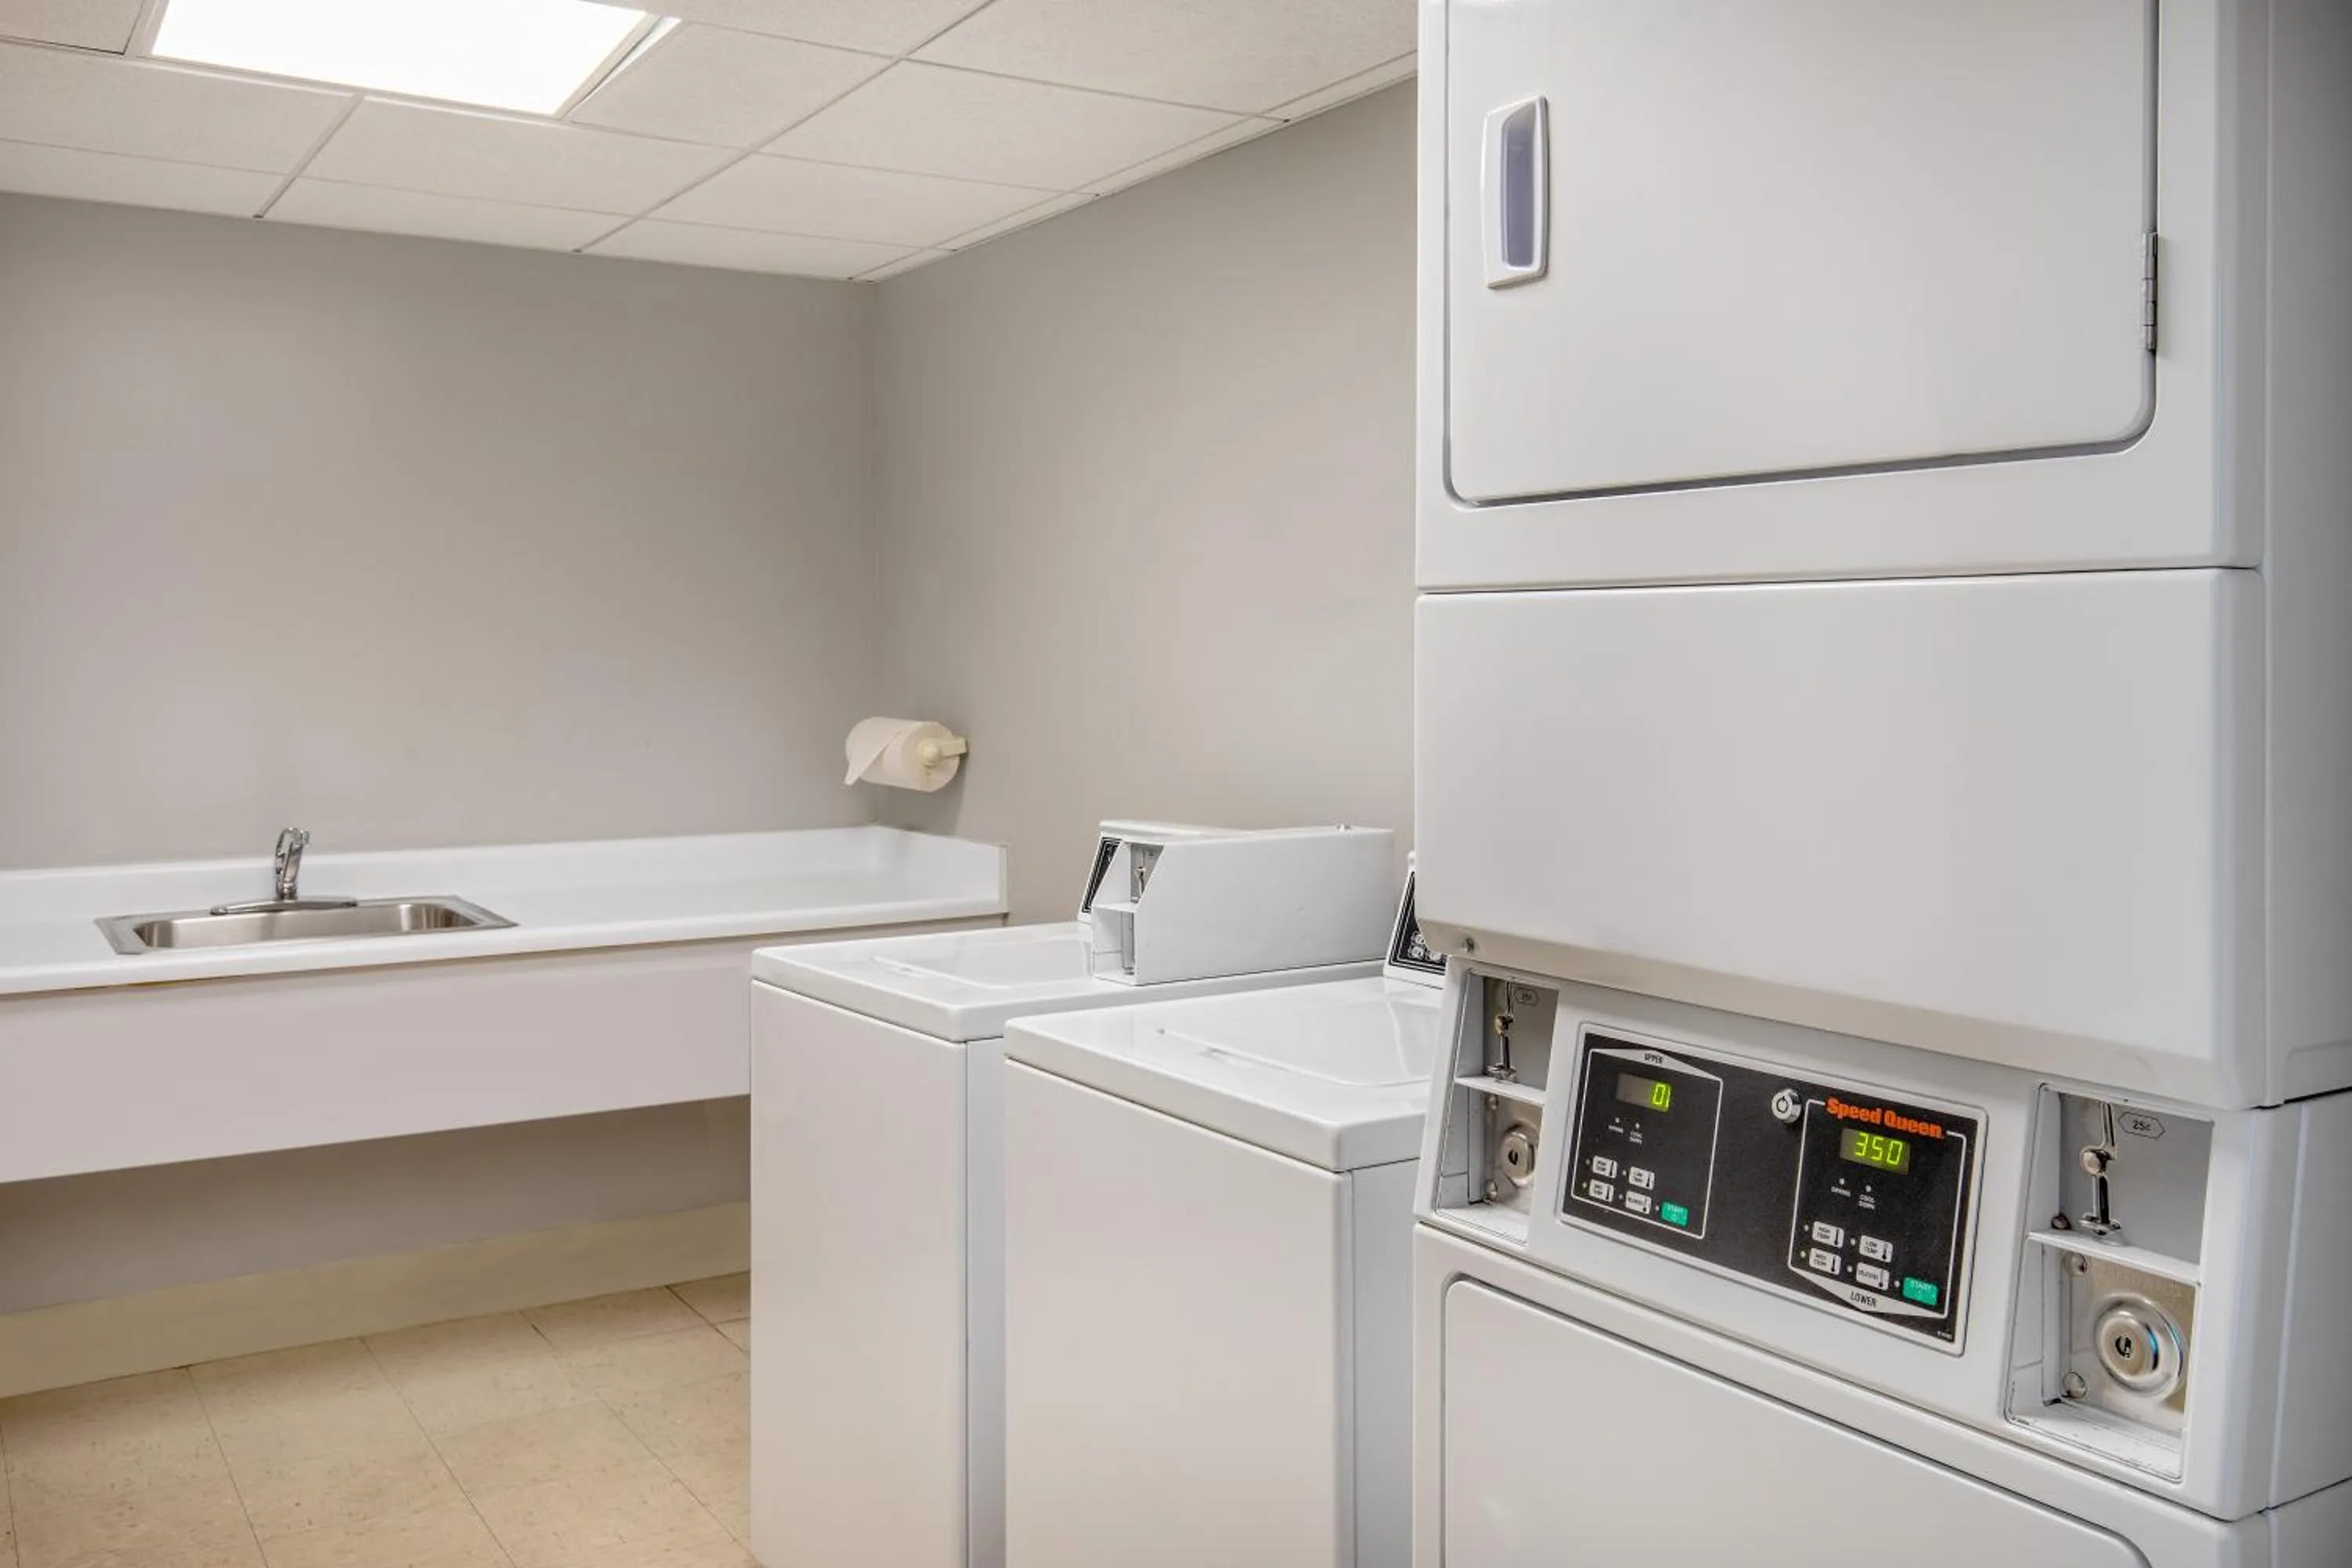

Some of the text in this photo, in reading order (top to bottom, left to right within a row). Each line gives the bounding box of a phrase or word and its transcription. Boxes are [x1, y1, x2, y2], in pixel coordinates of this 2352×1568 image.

[1826, 1097, 1943, 1139] Speed Queen
[1855, 1131, 1903, 1165] 350
[1850, 1291, 1877, 1307] LOWER
